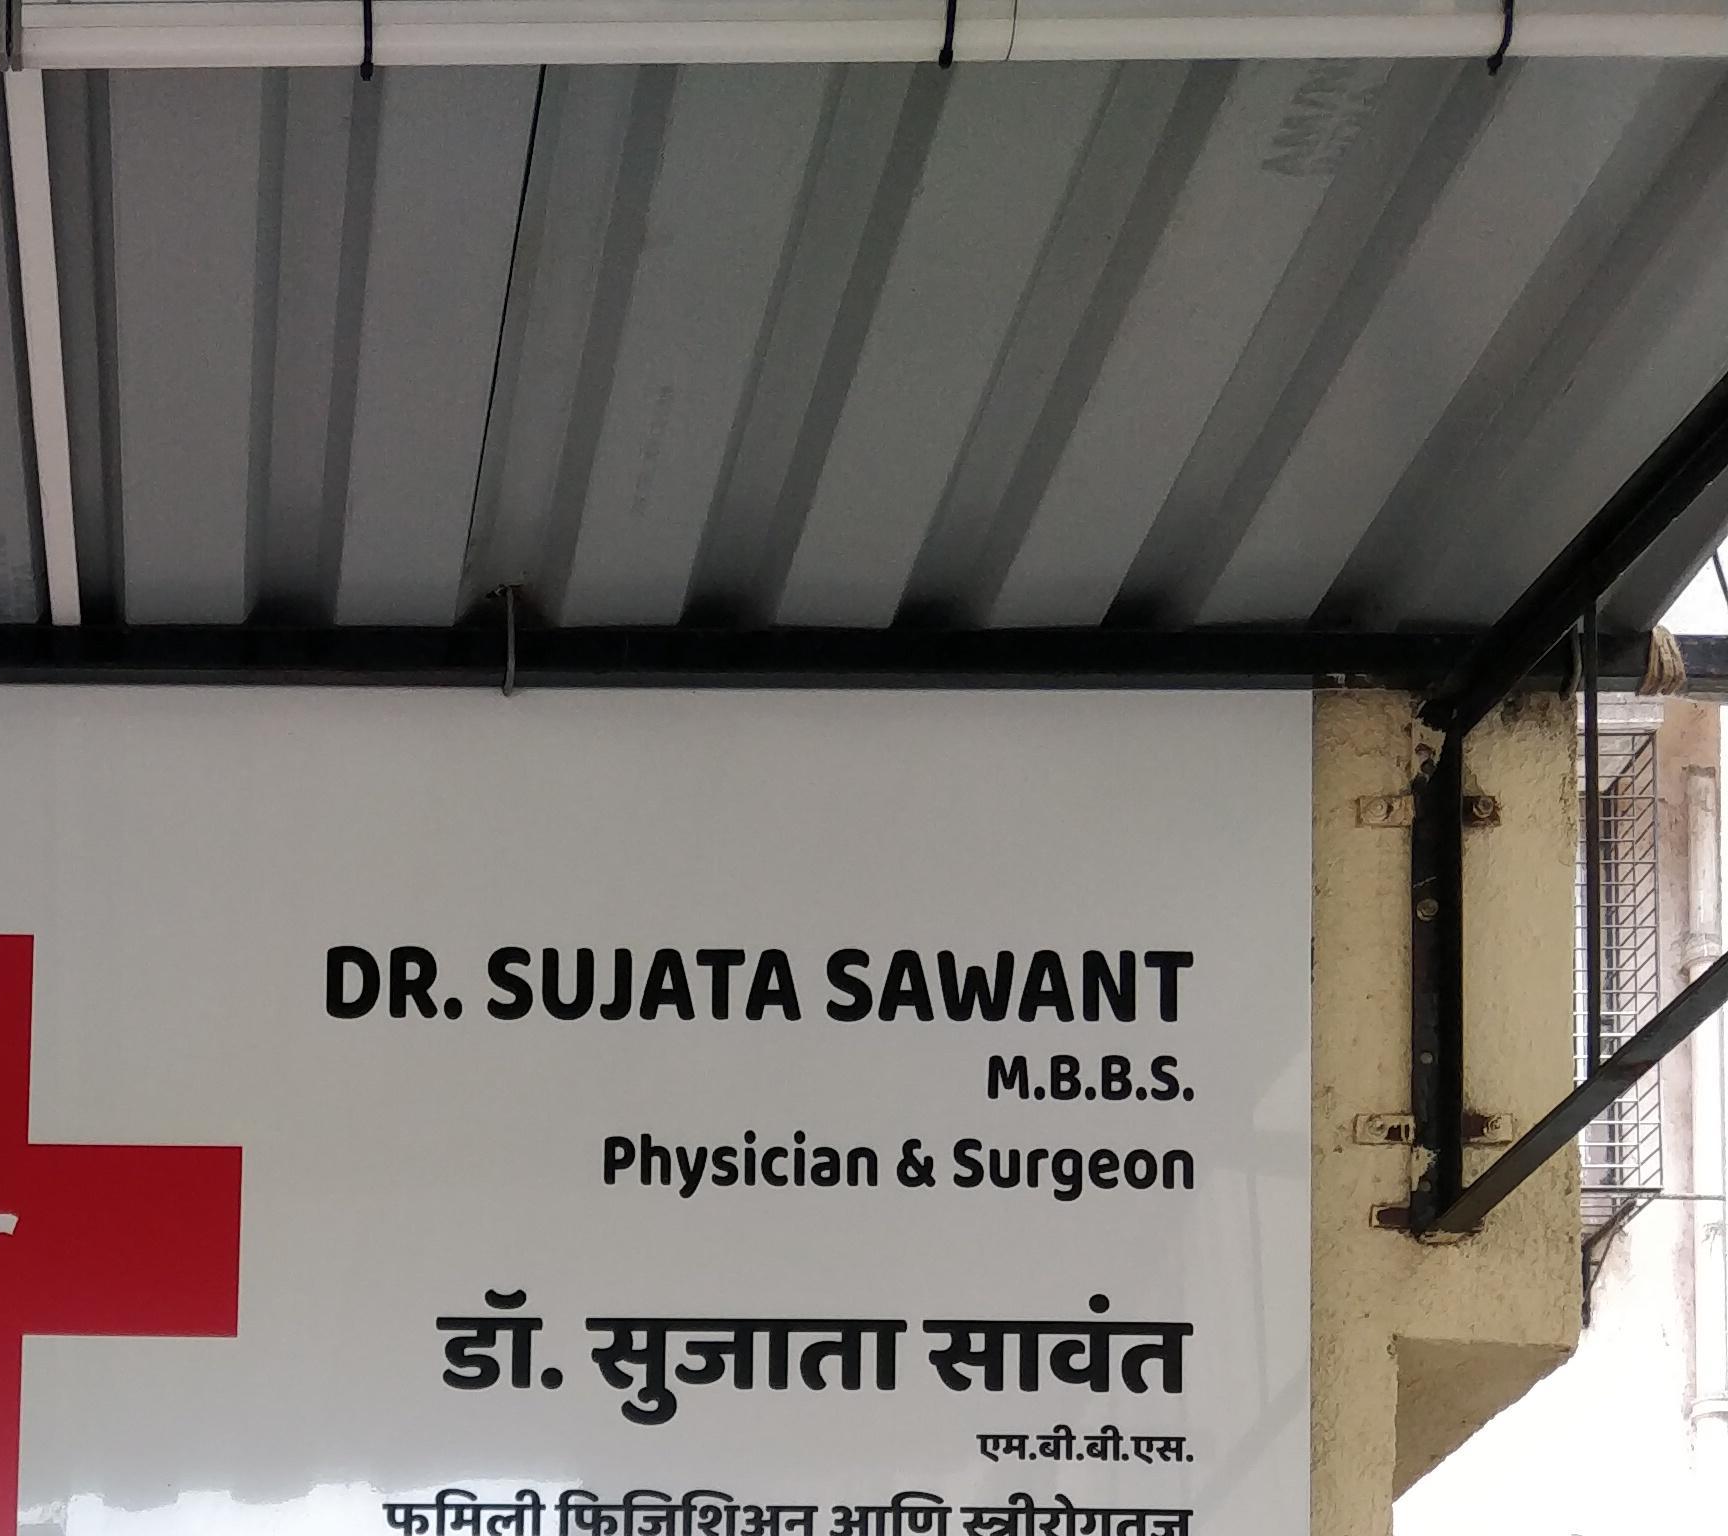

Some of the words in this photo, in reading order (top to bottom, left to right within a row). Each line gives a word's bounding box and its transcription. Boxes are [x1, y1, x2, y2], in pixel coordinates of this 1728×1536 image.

[325, 945, 463, 1020] DR.
[487, 946, 802, 1022] SUJATA
[826, 948, 1194, 1023] SAWANT
[987, 1054, 1195, 1102] M.B.B.S.
[603, 1129, 878, 1199] Physician
[896, 1138, 936, 1188] &
[953, 1138, 1194, 1202] Surgeon
[435, 1288, 564, 1390] डॉ.
[585, 1317, 908, 1426] सुजाता
[922, 1293, 1194, 1394] सावंत
[975, 1424, 1194, 1465] एम.बी.बी.एस.
